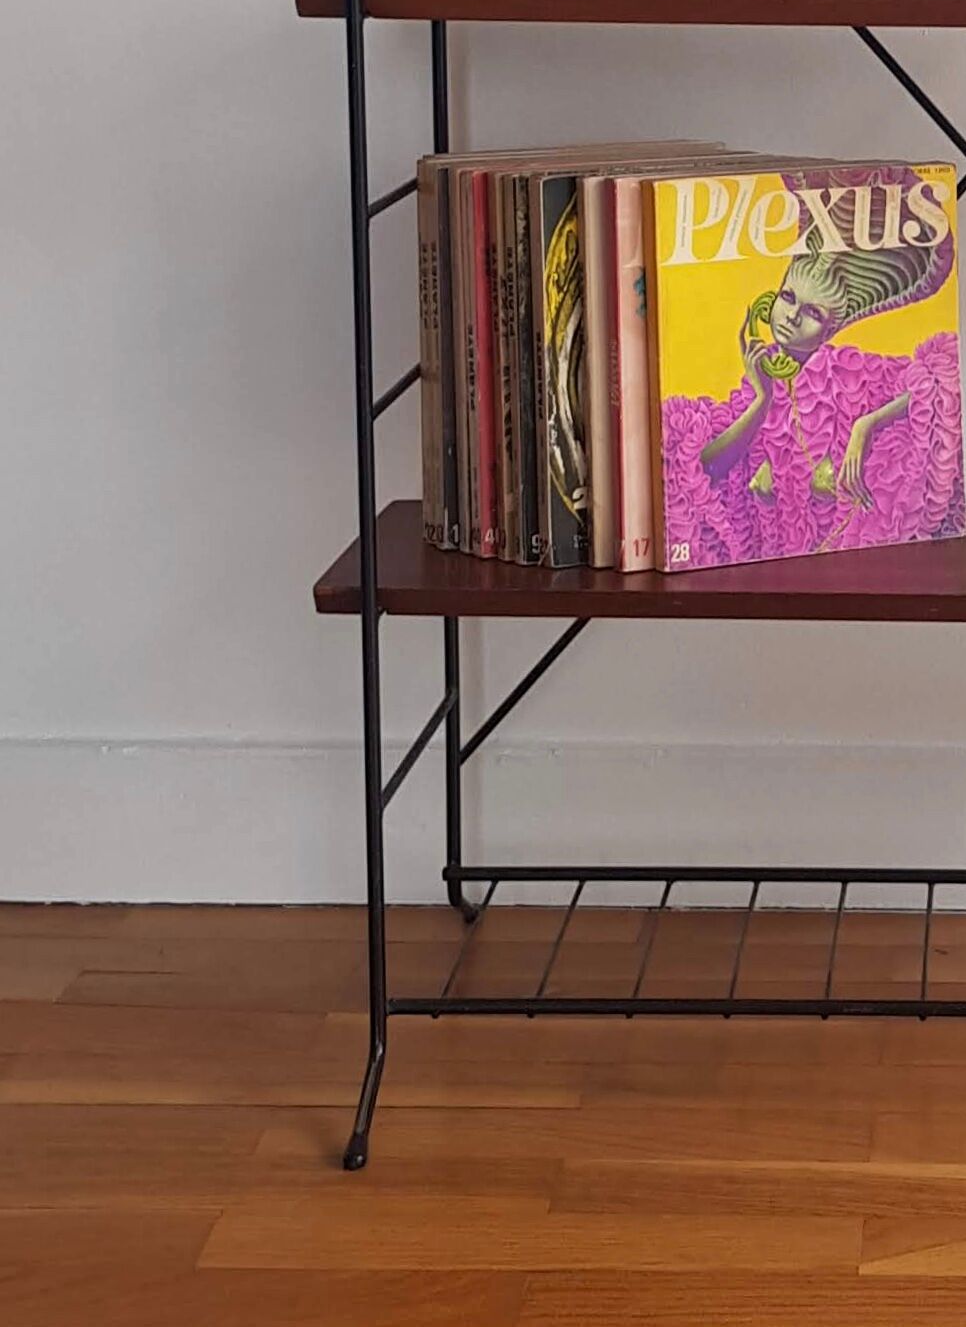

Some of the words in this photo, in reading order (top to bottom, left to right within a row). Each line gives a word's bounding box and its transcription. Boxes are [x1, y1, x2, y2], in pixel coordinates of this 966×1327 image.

[660, 175, 951, 266] Plexus
[633, 538, 649, 557] 17
[671, 543, 690, 563] 28
